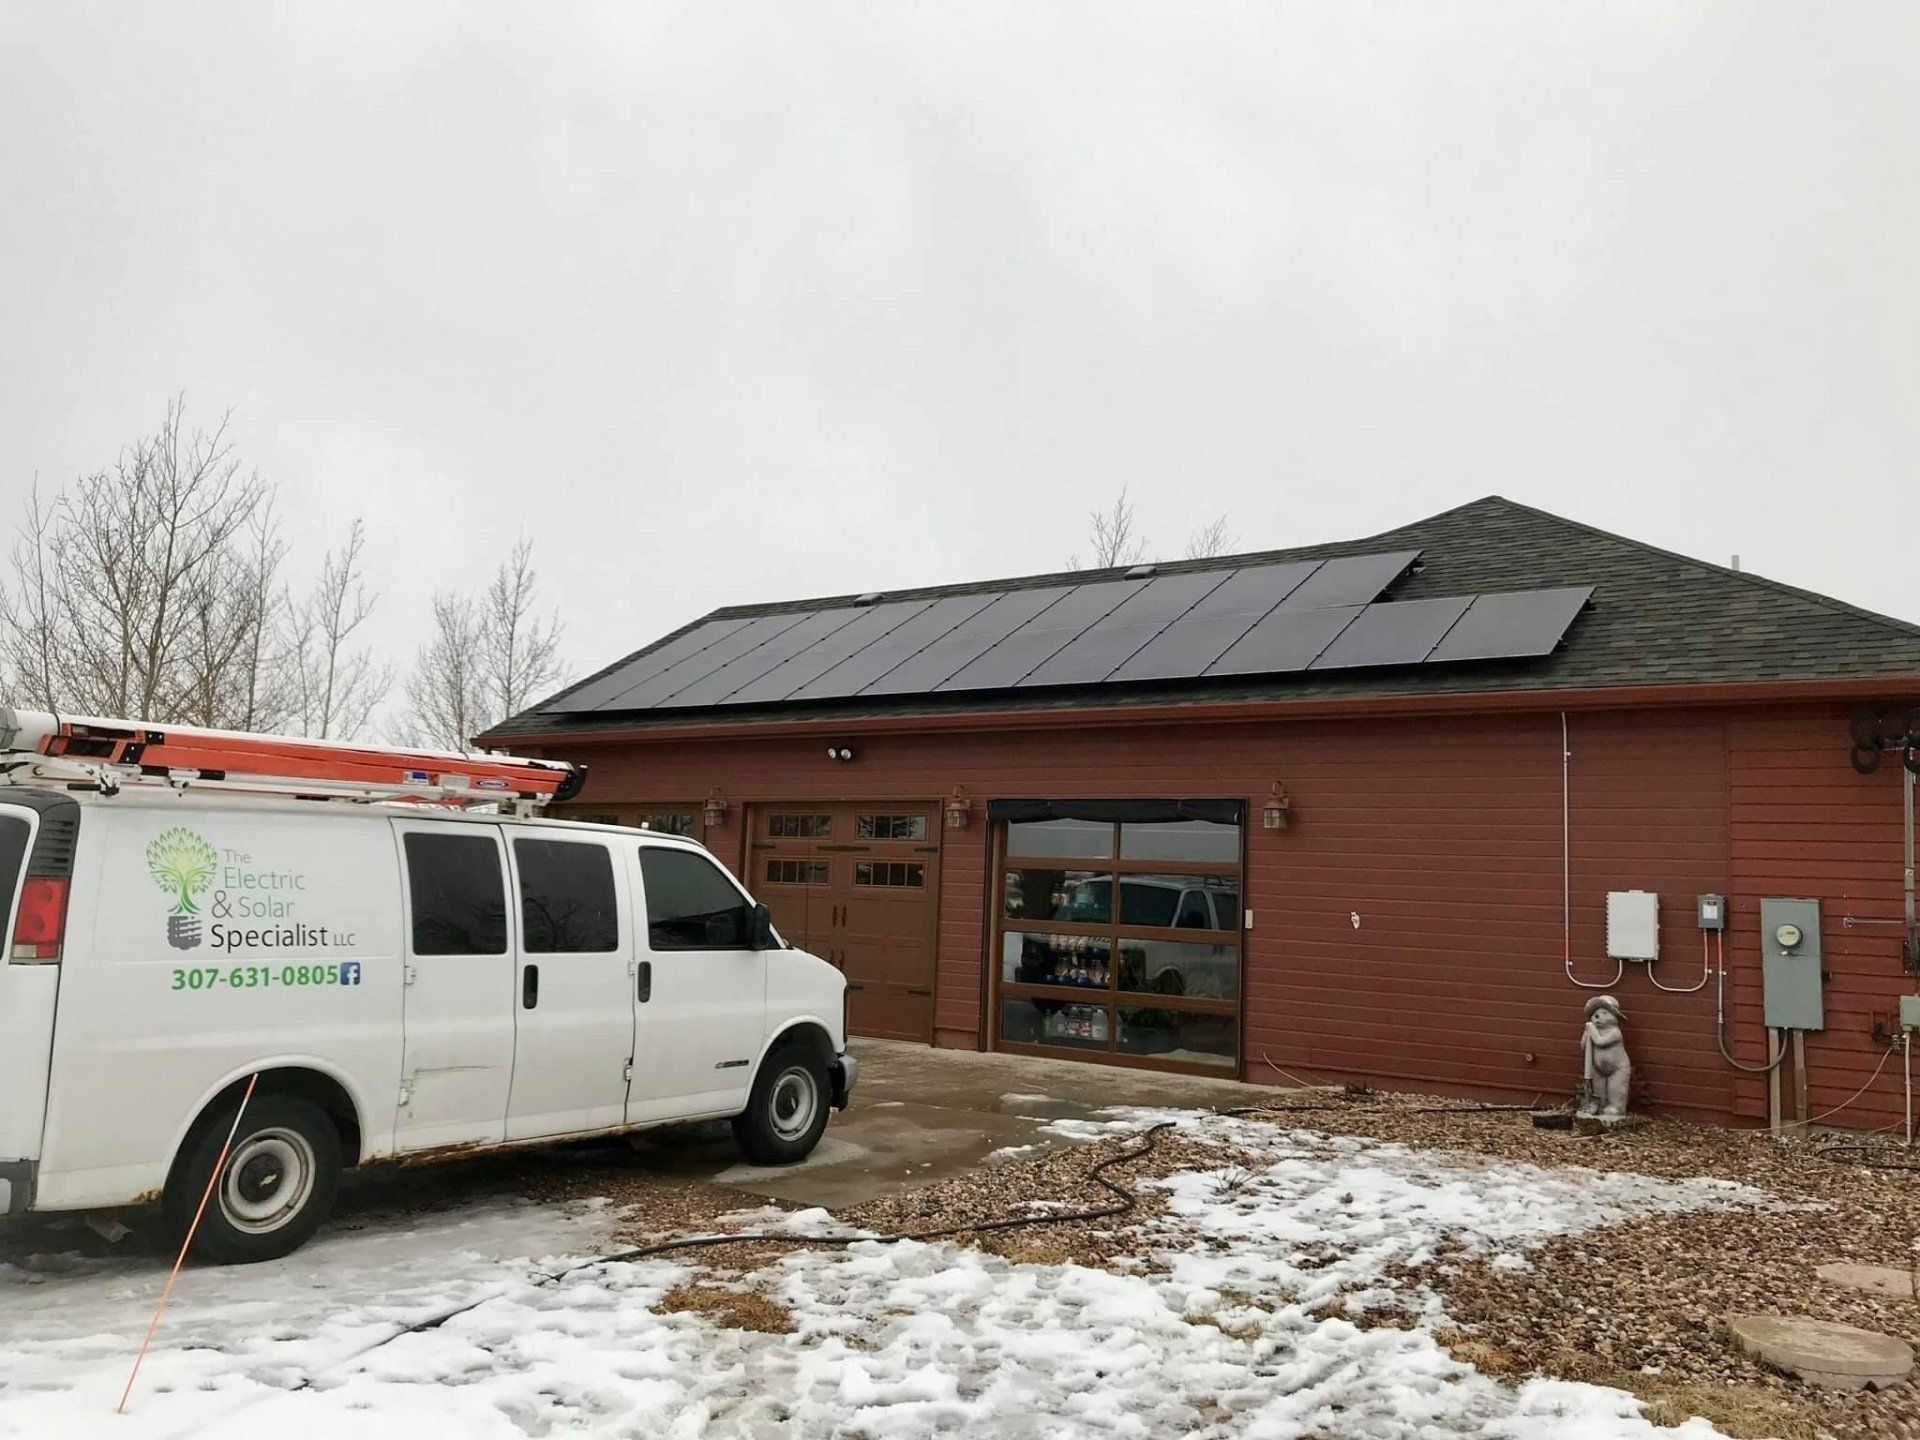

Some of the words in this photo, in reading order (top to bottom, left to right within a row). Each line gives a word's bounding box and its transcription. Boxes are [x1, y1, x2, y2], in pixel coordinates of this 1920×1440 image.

[221, 849, 252, 863] The
[224, 867, 306, 890] Electric
[211, 890, 233, 919] &
[238, 896, 295, 918] Solar
[210, 923, 328, 953] Specialist
[333, 932, 357, 946] LLC
[172, 965, 338, 990] 307-631-0805
